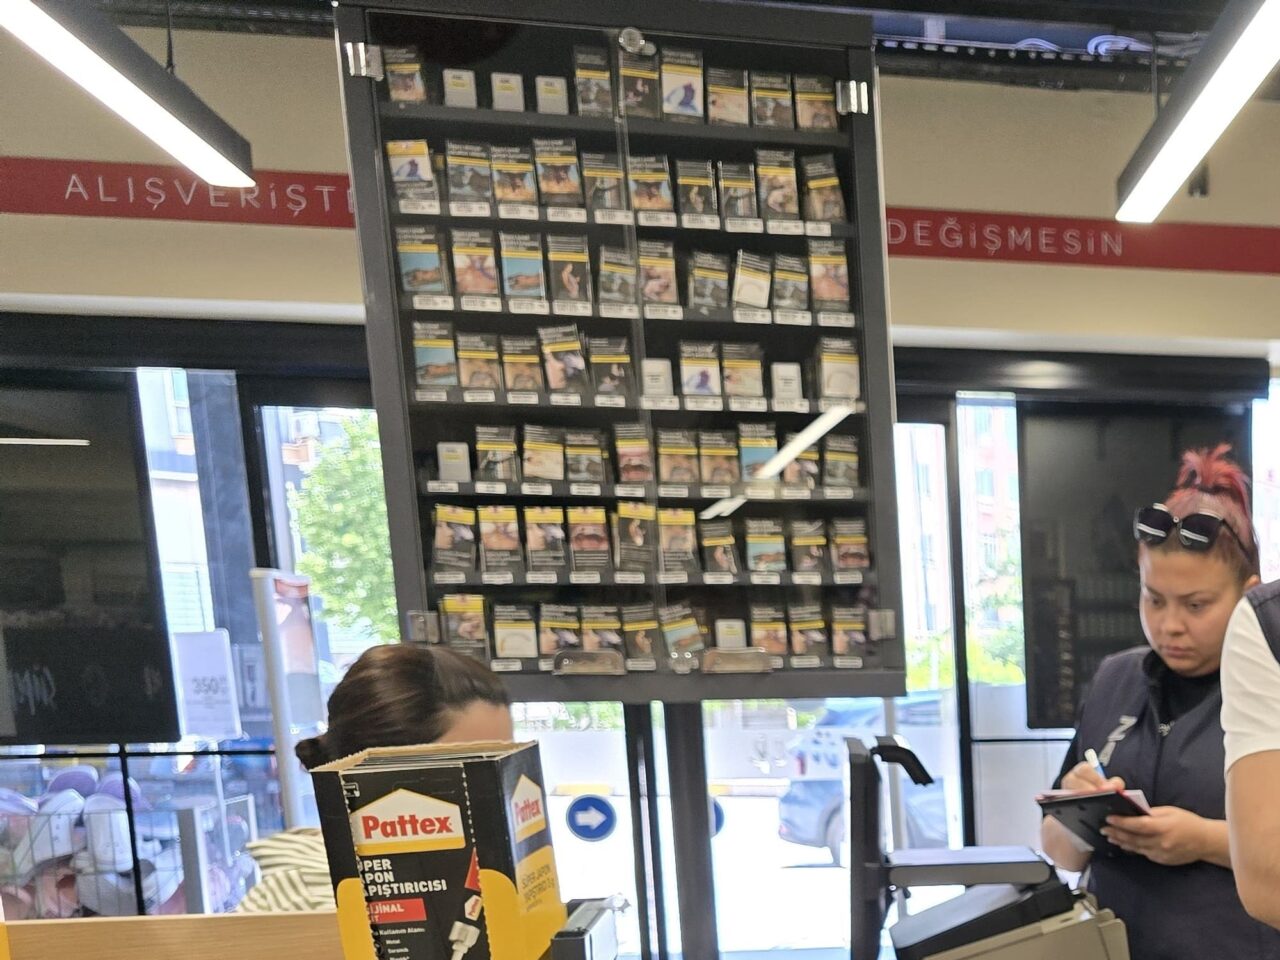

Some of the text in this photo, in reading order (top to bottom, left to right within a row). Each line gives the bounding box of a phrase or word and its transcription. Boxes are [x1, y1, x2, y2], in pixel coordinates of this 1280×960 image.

[64, 173, 355, 217] ALIŞVERİŞT
[887, 216, 1123, 256] DEĞİŞMESİN
[362, 814, 454, 839] Pattex
[361, 871, 395, 884] PON
